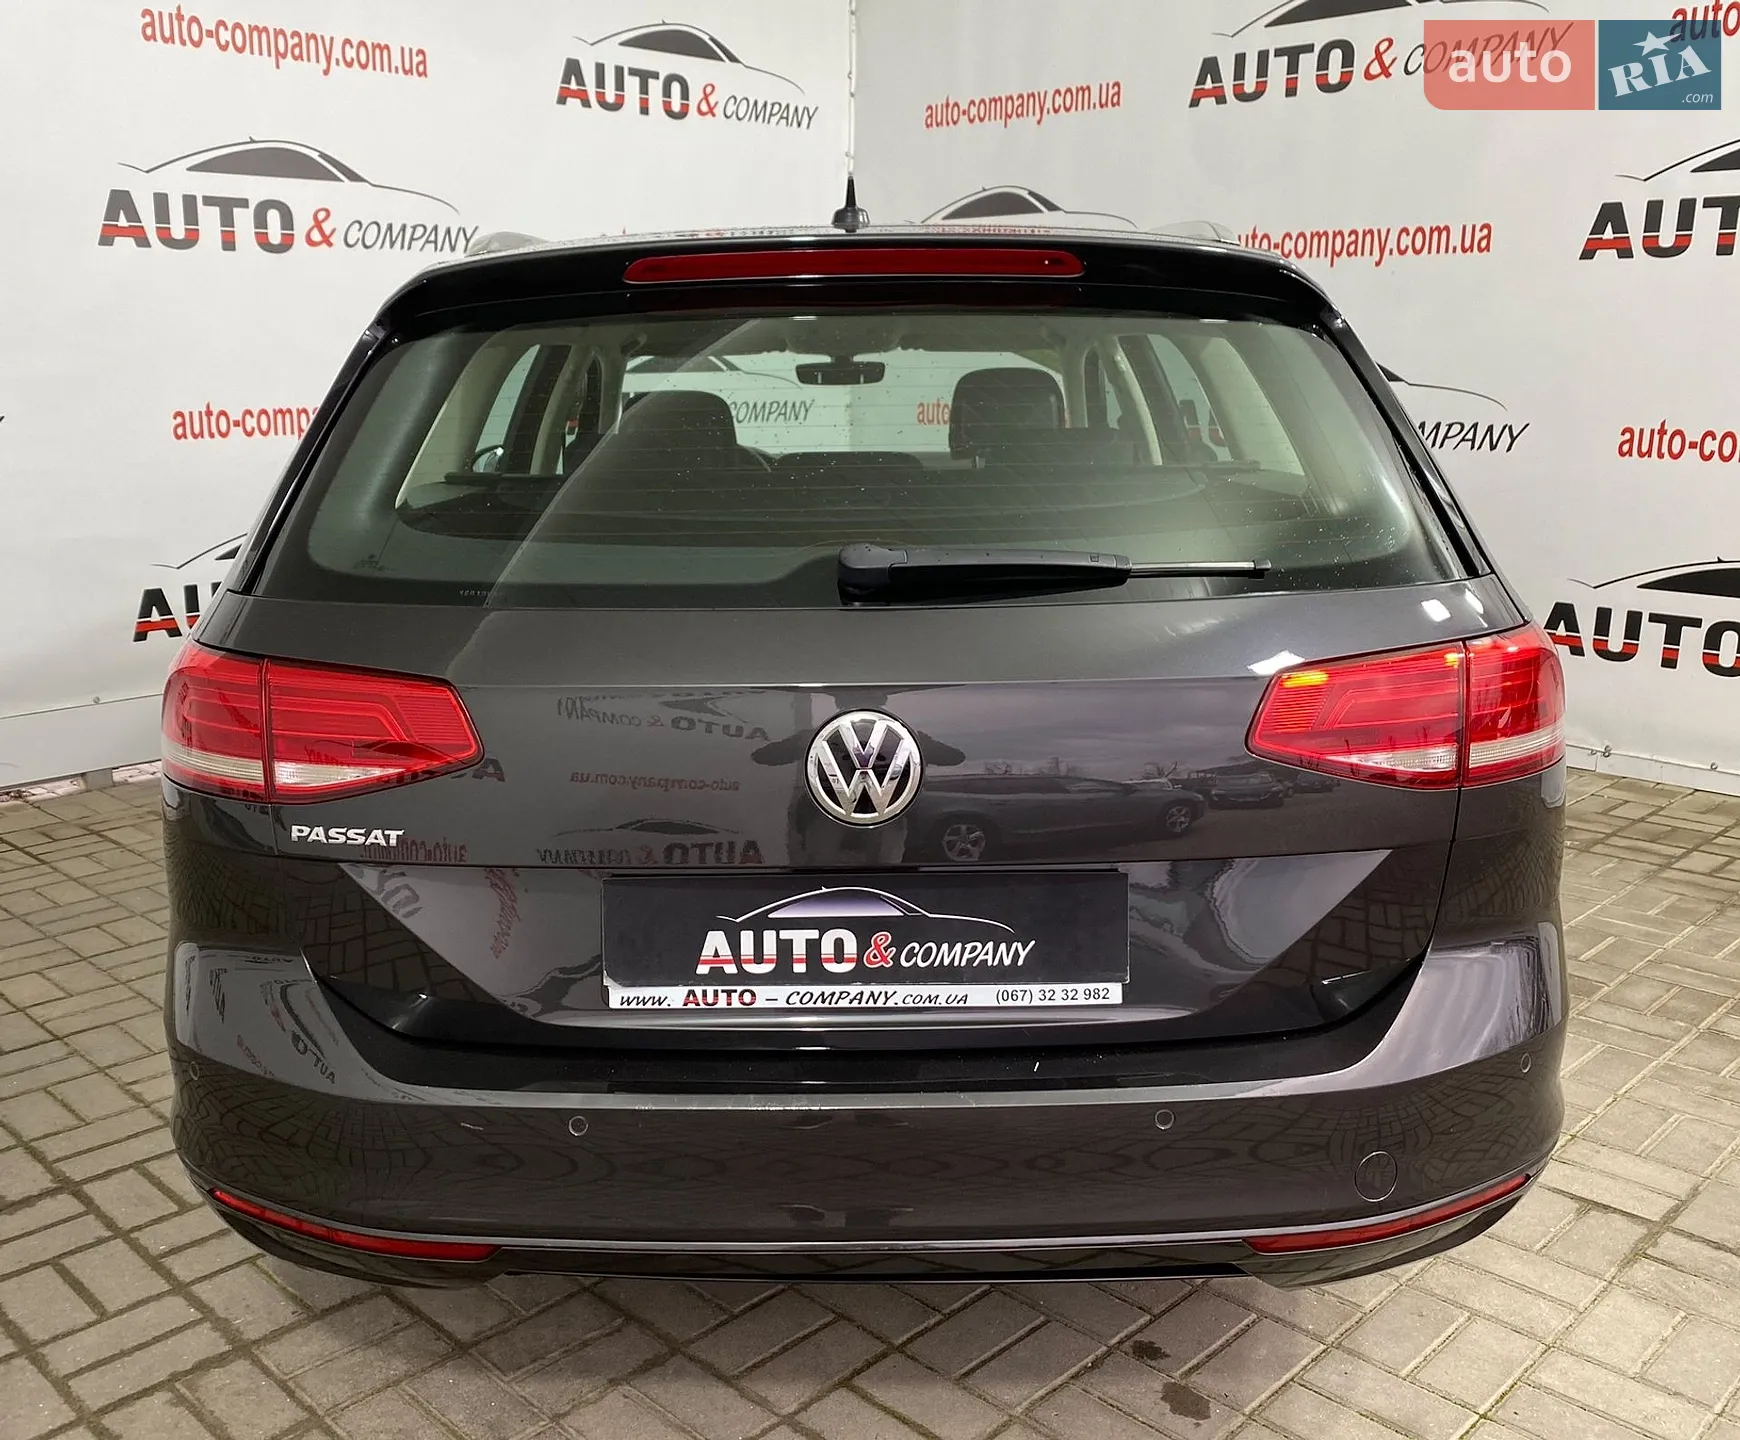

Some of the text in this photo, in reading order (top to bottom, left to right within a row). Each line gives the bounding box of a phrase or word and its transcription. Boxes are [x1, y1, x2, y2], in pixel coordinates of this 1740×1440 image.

[141, 4, 428, 78] auto-company.com.ua
[556, 57, 819, 130] AUTO & COMPANY
[1189, 38, 1355, 108] AUTO
[1363, 37, 1396, 81] &
[924, 81, 1122, 129] auto-company.com.ua
[97, 188, 479, 255] AUTO & COMPANY
[1238, 221, 1493, 267] uto-company.com.ua
[1418, 421, 1530, 453] MPANY
[1618, 419, 1740, 463] auto-co
[291, 825, 405, 847] PASSAT
[695, 928, 1036, 975] AUTO & COMPANY
[682, 988, 758, 1007] AUTO
[995, 988, 1033, 1005] (067)
[1038, 988, 1056, 1001] 32
[1061, 988, 1079, 1001] 32
[1083, 987, 1110, 1001] 982
